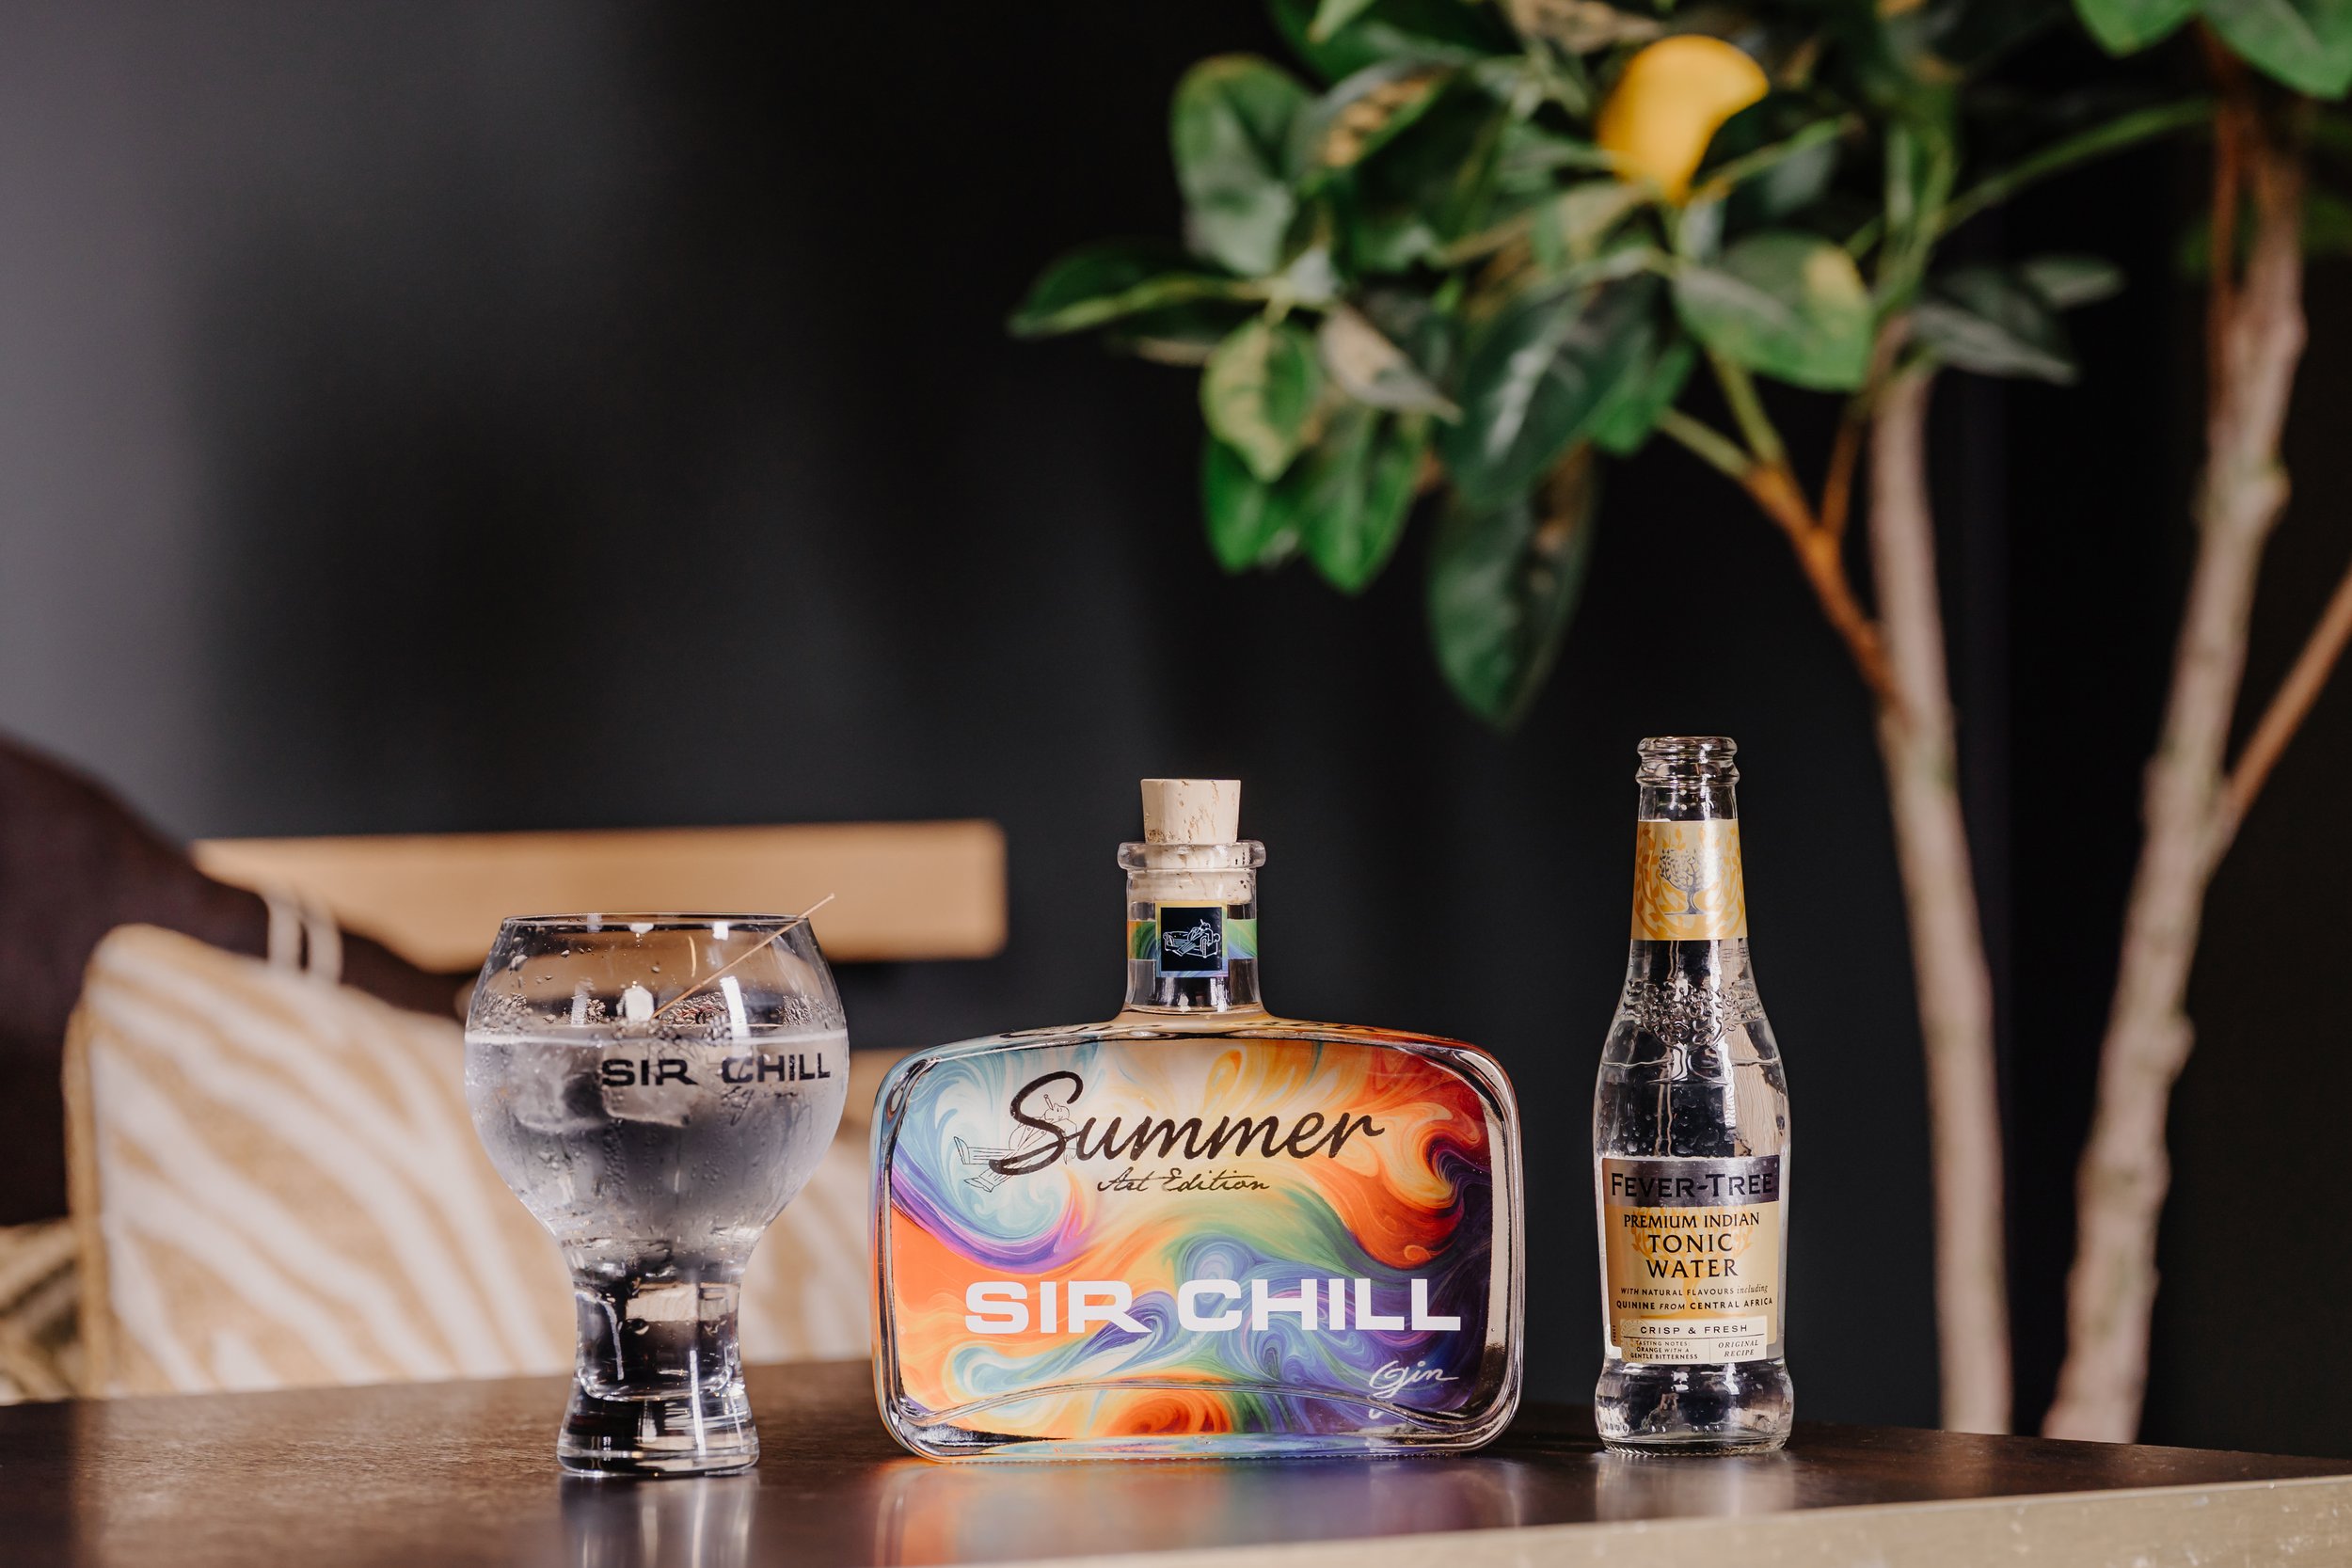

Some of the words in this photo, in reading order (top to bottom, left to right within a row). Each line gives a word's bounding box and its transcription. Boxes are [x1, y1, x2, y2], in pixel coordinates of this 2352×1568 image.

[601, 1058, 698, 1086] SIR
[722, 1053, 831, 1083] CHILL
[989, 1070, 1384, 1176] Summer
[1097, 1166, 1152, 1192] Art
[1161, 1167, 1271, 1192] Edition
[1612, 1172, 1772, 1197] FEVER-TREE
[1625, 1214, 1696, 1227] PREMIUM
[1705, 1212, 1759, 1227] INDIAN
[1648, 1233, 1733, 1253] TONIC
[1646, 1259, 1739, 1278] WATER
[1737, 1284, 1768, 1294] including
[965, 1280, 1153, 1334] SIR
[1178, 1278, 1461, 1332] CHILL
[1616, 1300, 1655, 1309] QUININE
[1691, 1301, 1739, 1309] CENTRAL
[1744, 1298, 1772, 1307] AFRICA
[1705, 1324, 1747, 1333] FRESH
[1718, 1339, 1758, 1349] ORIGINAL
[1370, 1361, 1458, 1401] Gin
